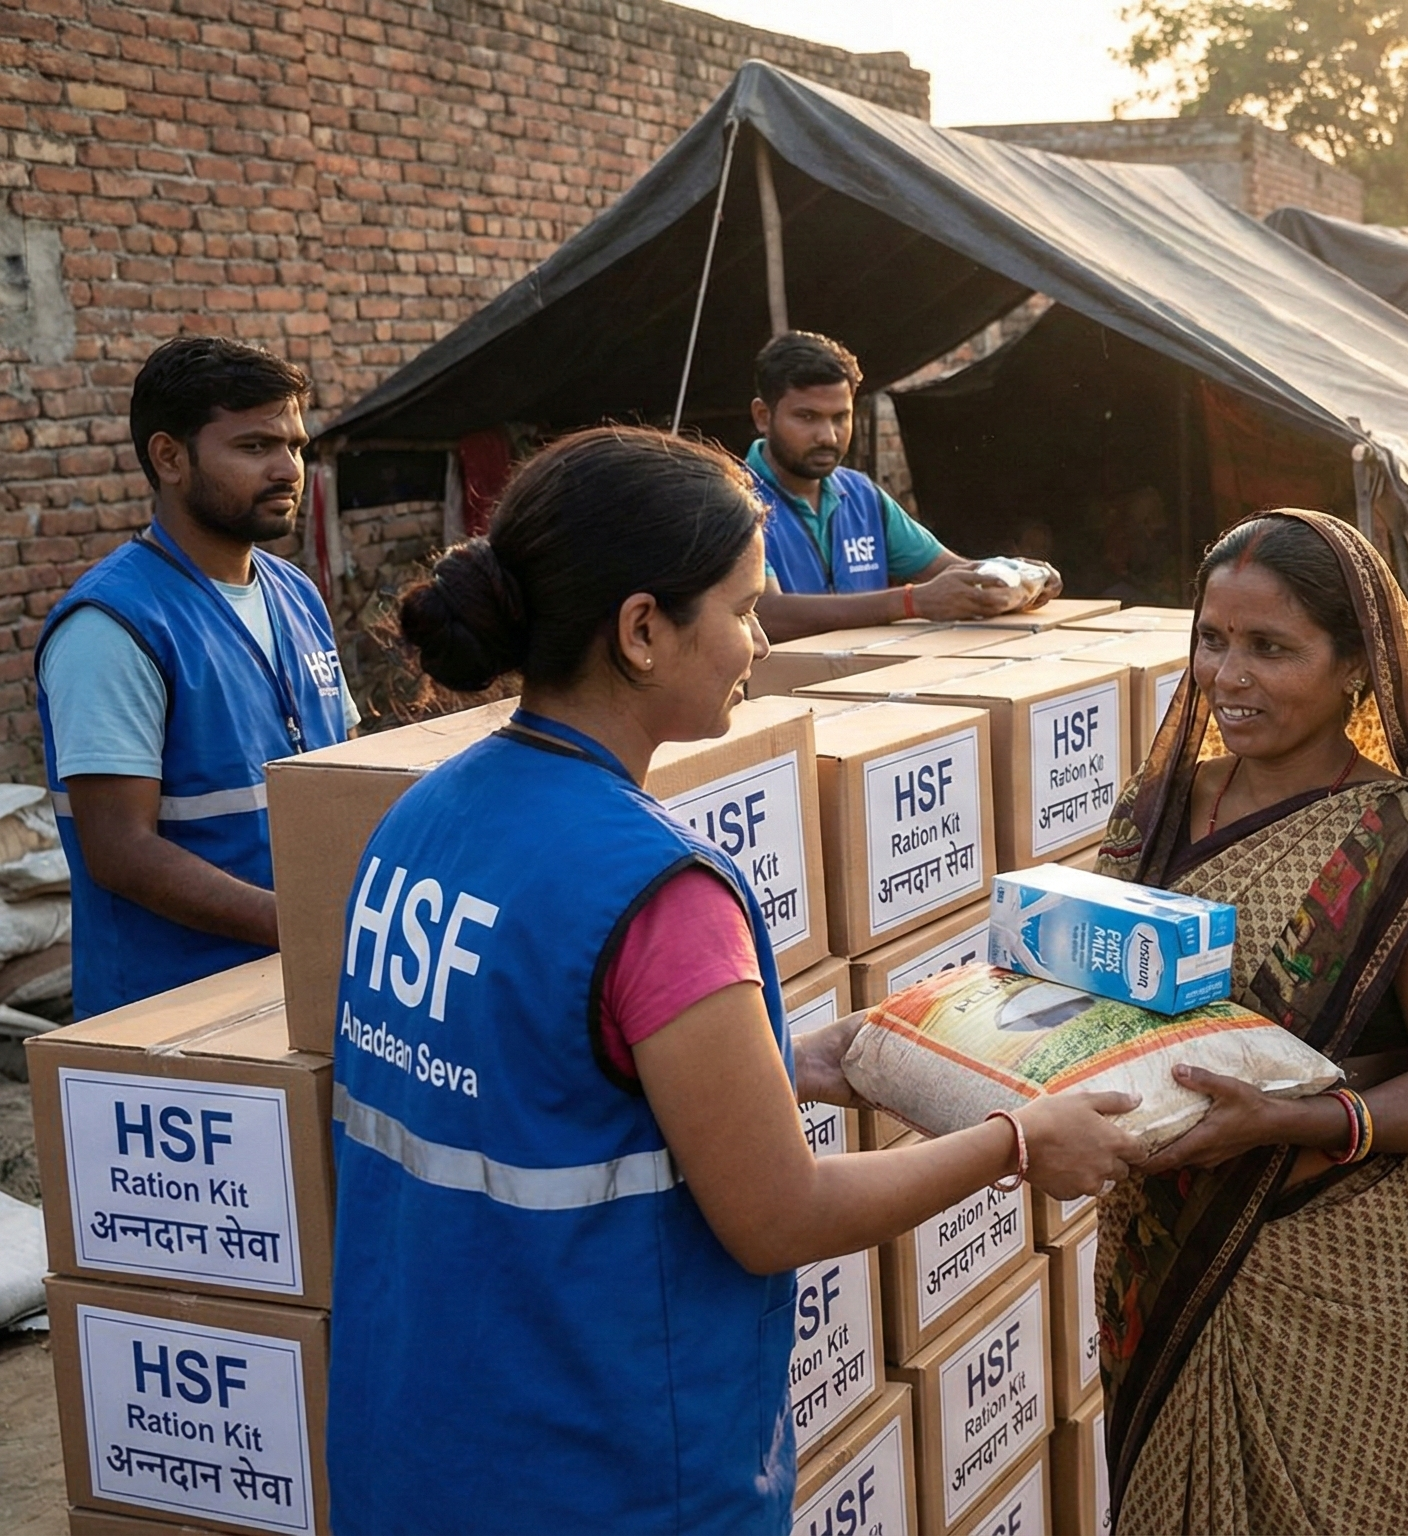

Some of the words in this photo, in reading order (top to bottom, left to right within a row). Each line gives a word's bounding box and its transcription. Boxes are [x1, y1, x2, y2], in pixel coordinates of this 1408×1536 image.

[844, 536, 875, 563] HSF
[1054, 706, 1099, 759] HSF
[895, 758, 952, 822] HSF
[1092, 778, 1114, 810] सेवा
[892, 826, 938, 858] Ration
[941, 812, 960, 838] Kit
[752, 852, 779, 886] Kit
[878, 856, 941, 904] अन्नदान
[945, 841, 975, 878] सेवा
[346, 856, 500, 1022] HSF
[341, 1001, 413, 1075] Anadaan
[416, 1042, 479, 1098] Seva
[114, 1101, 233, 1165] HSF
[110, 1167, 200, 1203] Ration
[209, 1177, 249, 1208] Kit
[90, 1210, 208, 1256] अन्नदान
[216, 1215, 280, 1264] सेवा
[926, 1232, 986, 1295] अन्नदान
[989, 1207, 1017, 1246] सेवा
[938, 1202, 983, 1247] Ration
[798, 1265, 840, 1340] SF
[827, 1323, 850, 1357] Kit
[967, 1321, 1020, 1409] HSF
[132, 1340, 247, 1408] HSF
[832, 1349, 865, 1396] सेवा
[127, 1403, 214, 1444] Ration
[224, 1421, 263, 1452] Kit
[965, 1394, 1006, 1443] Ration
[1009, 1371, 1026, 1401] Kit
[952, 1422, 1008, 1491] अन्नदान
[1012, 1394, 1037, 1435] सेवा
[106, 1443, 222, 1494] अन्नदान
[231, 1456, 293, 1507] सेवा
